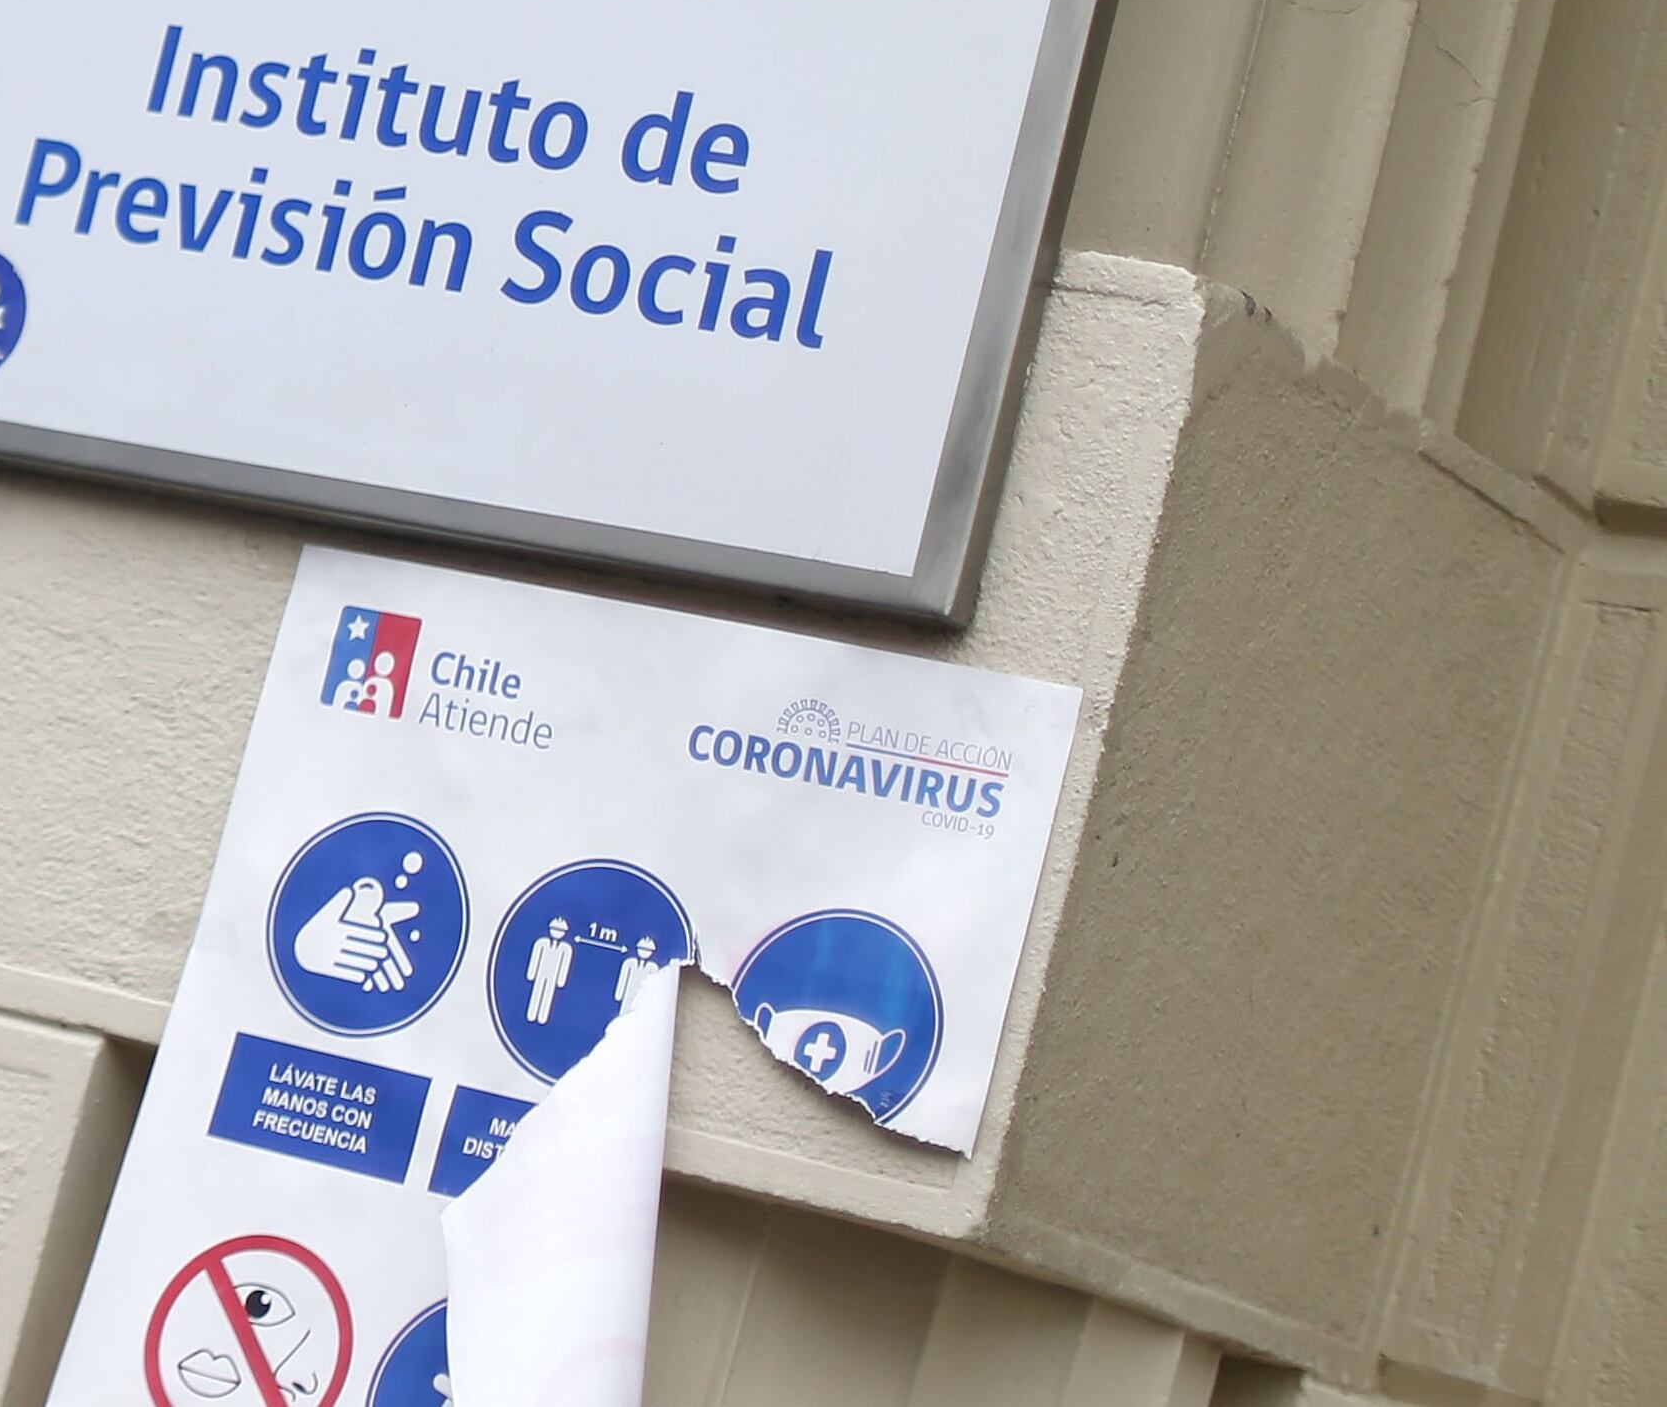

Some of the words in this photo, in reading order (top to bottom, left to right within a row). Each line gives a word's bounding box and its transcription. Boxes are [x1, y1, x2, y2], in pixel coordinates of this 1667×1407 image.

[146, 24, 589, 173] Instituto
[620, 90, 751, 194] de
[14, 138, 473, 293] Previsión
[500, 210, 834, 349] Social
[430, 652, 522, 699] Chile
[419, 692, 553, 750] Atiende
[846, 720, 899, 749] PLAN
[904, 732, 932, 755] DE
[935, 739, 1013, 771] ACCIÓN
[688, 724, 1005, 818] CORONAVIRUS
[921, 810, 995, 840] COVID-19
[261, 1086, 328, 1118] MANOS
[331, 1104, 372, 1130] CON
[269, 1062, 338, 1096] LÁVATE
[340, 1080, 376, 1105] LAS
[252, 1109, 368, 1154] FRECUENCIA
